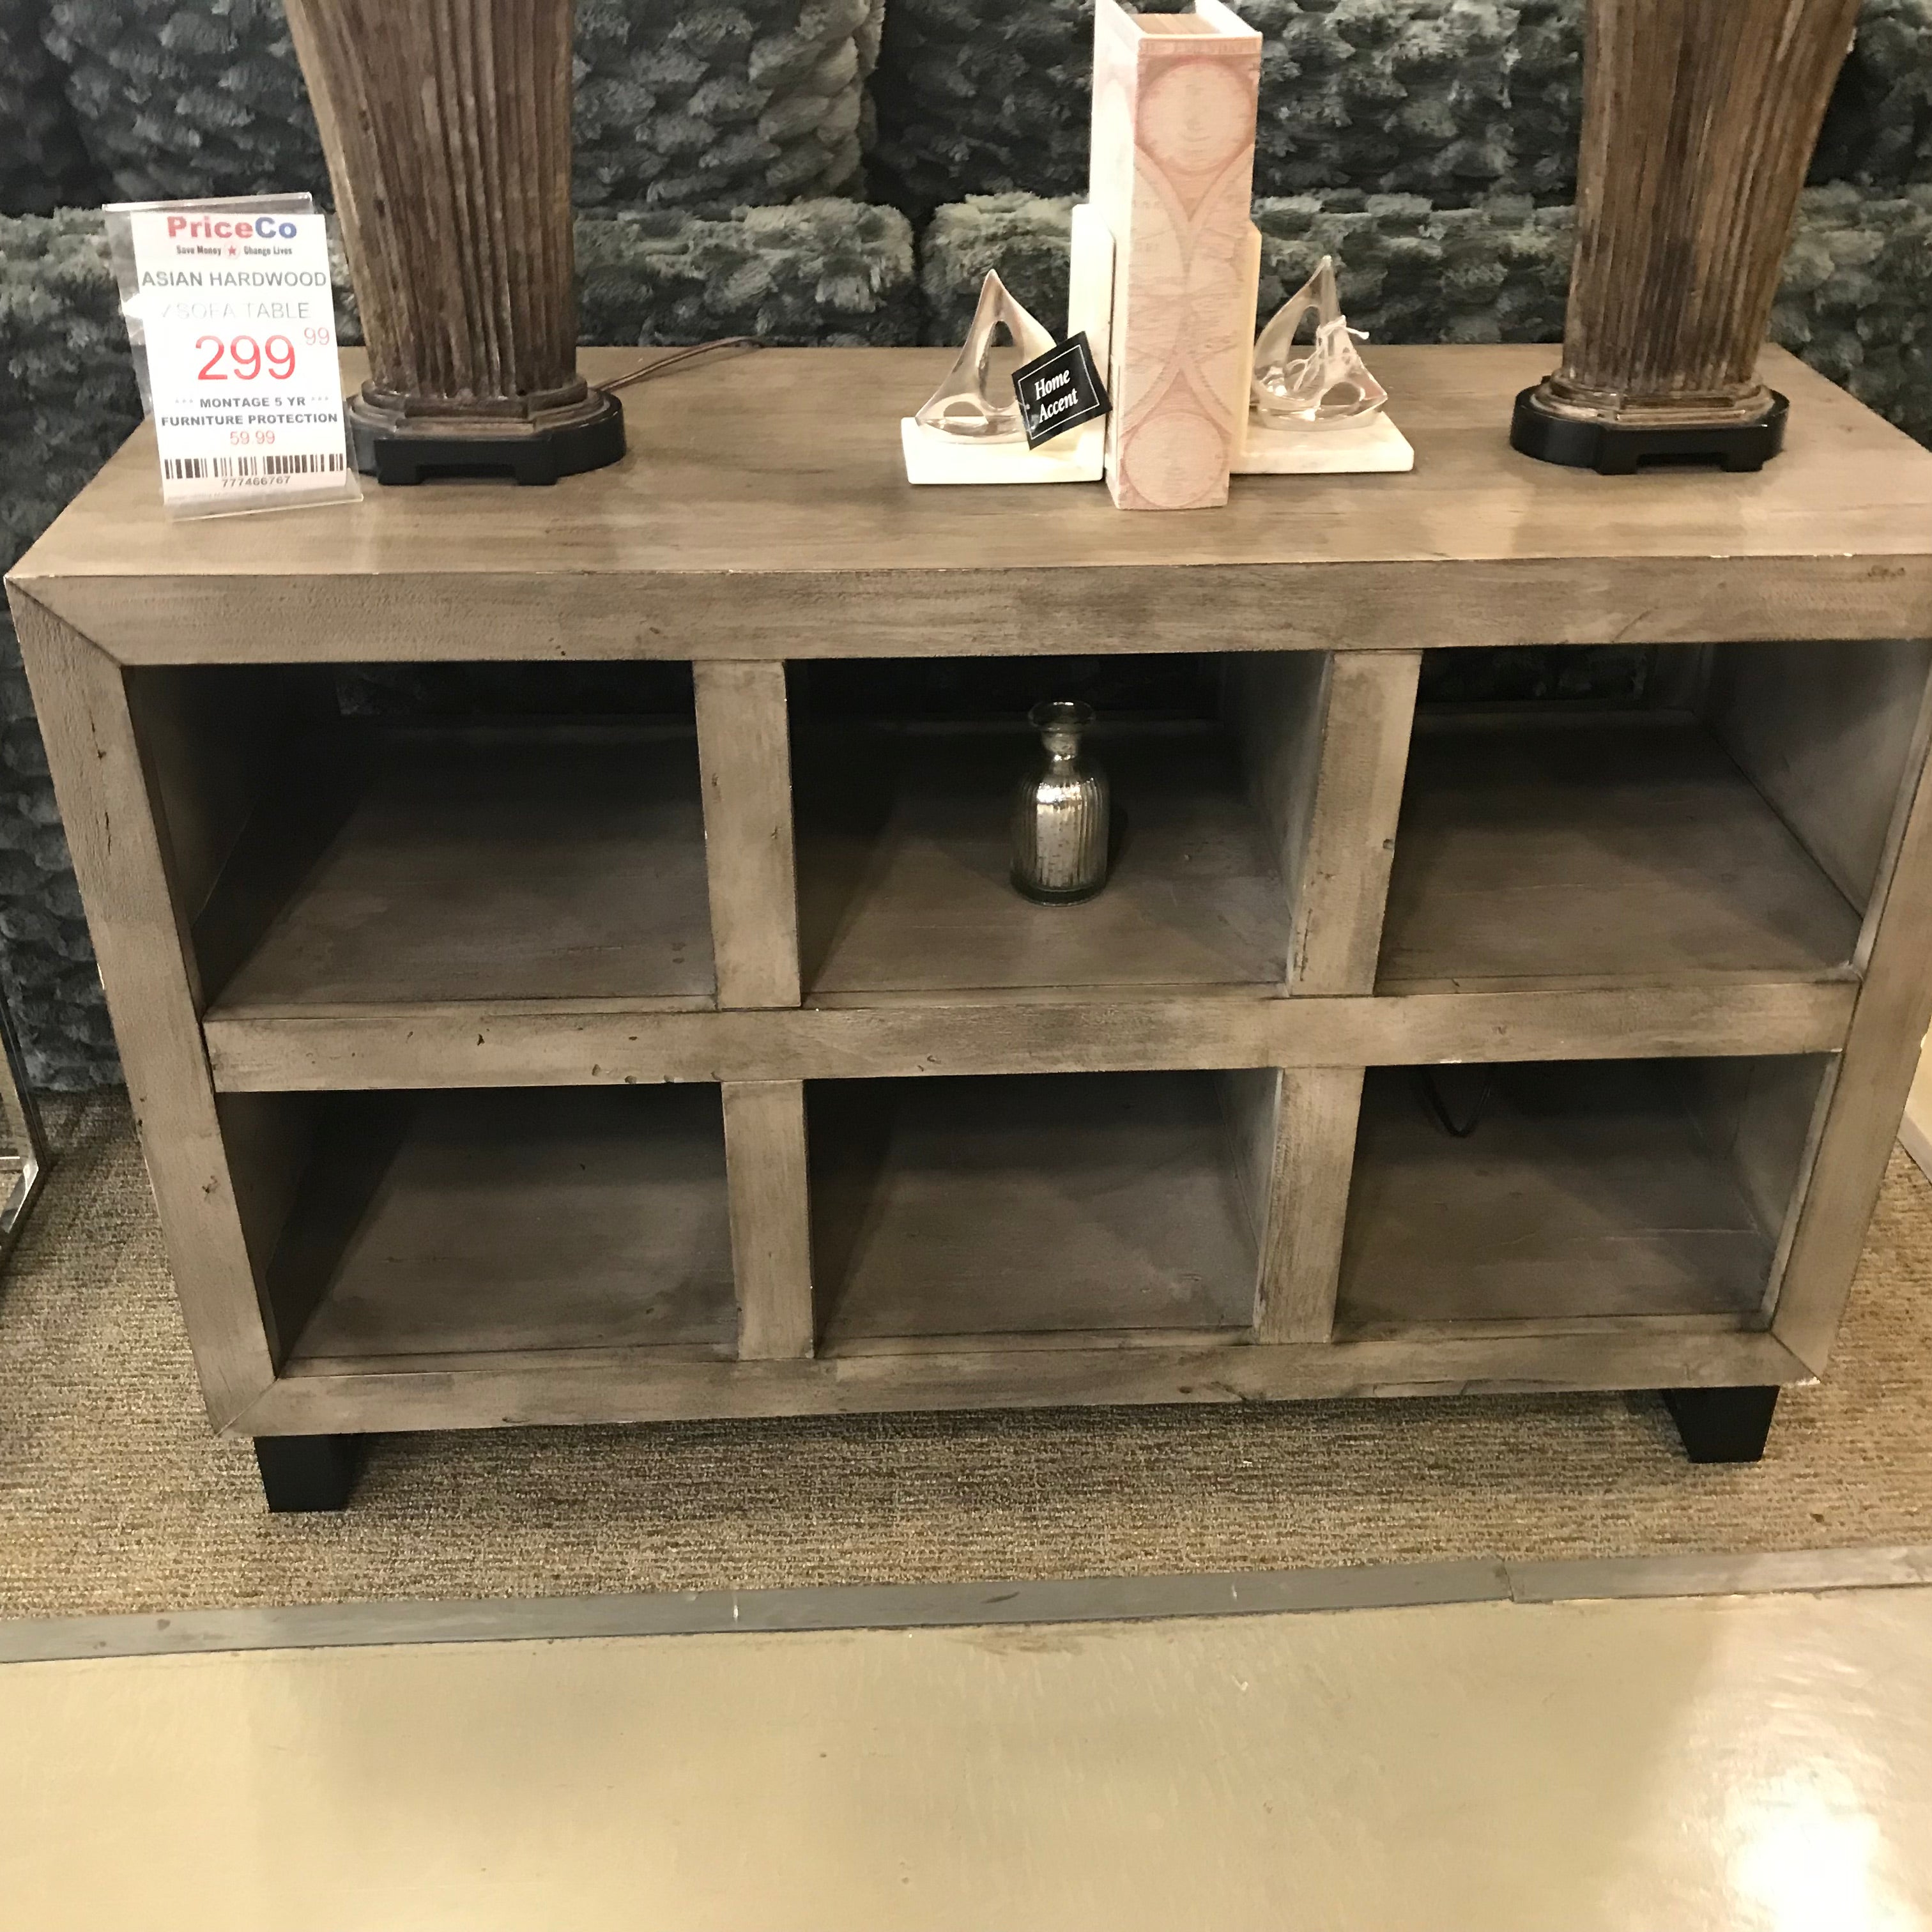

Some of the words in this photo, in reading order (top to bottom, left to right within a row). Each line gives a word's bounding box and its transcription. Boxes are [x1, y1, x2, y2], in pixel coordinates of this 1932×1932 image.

[167, 216, 297, 239] PriceCo
[176, 245, 194, 254] Save
[197, 245, 221, 256] Money
[243, 245, 271, 256] Change
[273, 245, 293, 254] Lives
[142, 271, 203, 286] ASIAN
[210, 271, 327, 286] HARDWOOD
[244, 302, 312, 319] TABLE
[195, 335, 296, 380] 299
[303, 327, 330, 346] 99
[1034, 369, 1071, 401] Home
[200, 397, 270, 408] MONTAGE
[275, 397, 282, 407] 5
[287, 397, 306, 407] YR
[1039, 388, 1078, 423] Accent
[161, 415, 243, 426] FURNITURE
[248, 413, 338, 424] PROTECTION
[222, 475, 291, 488] 777466767
